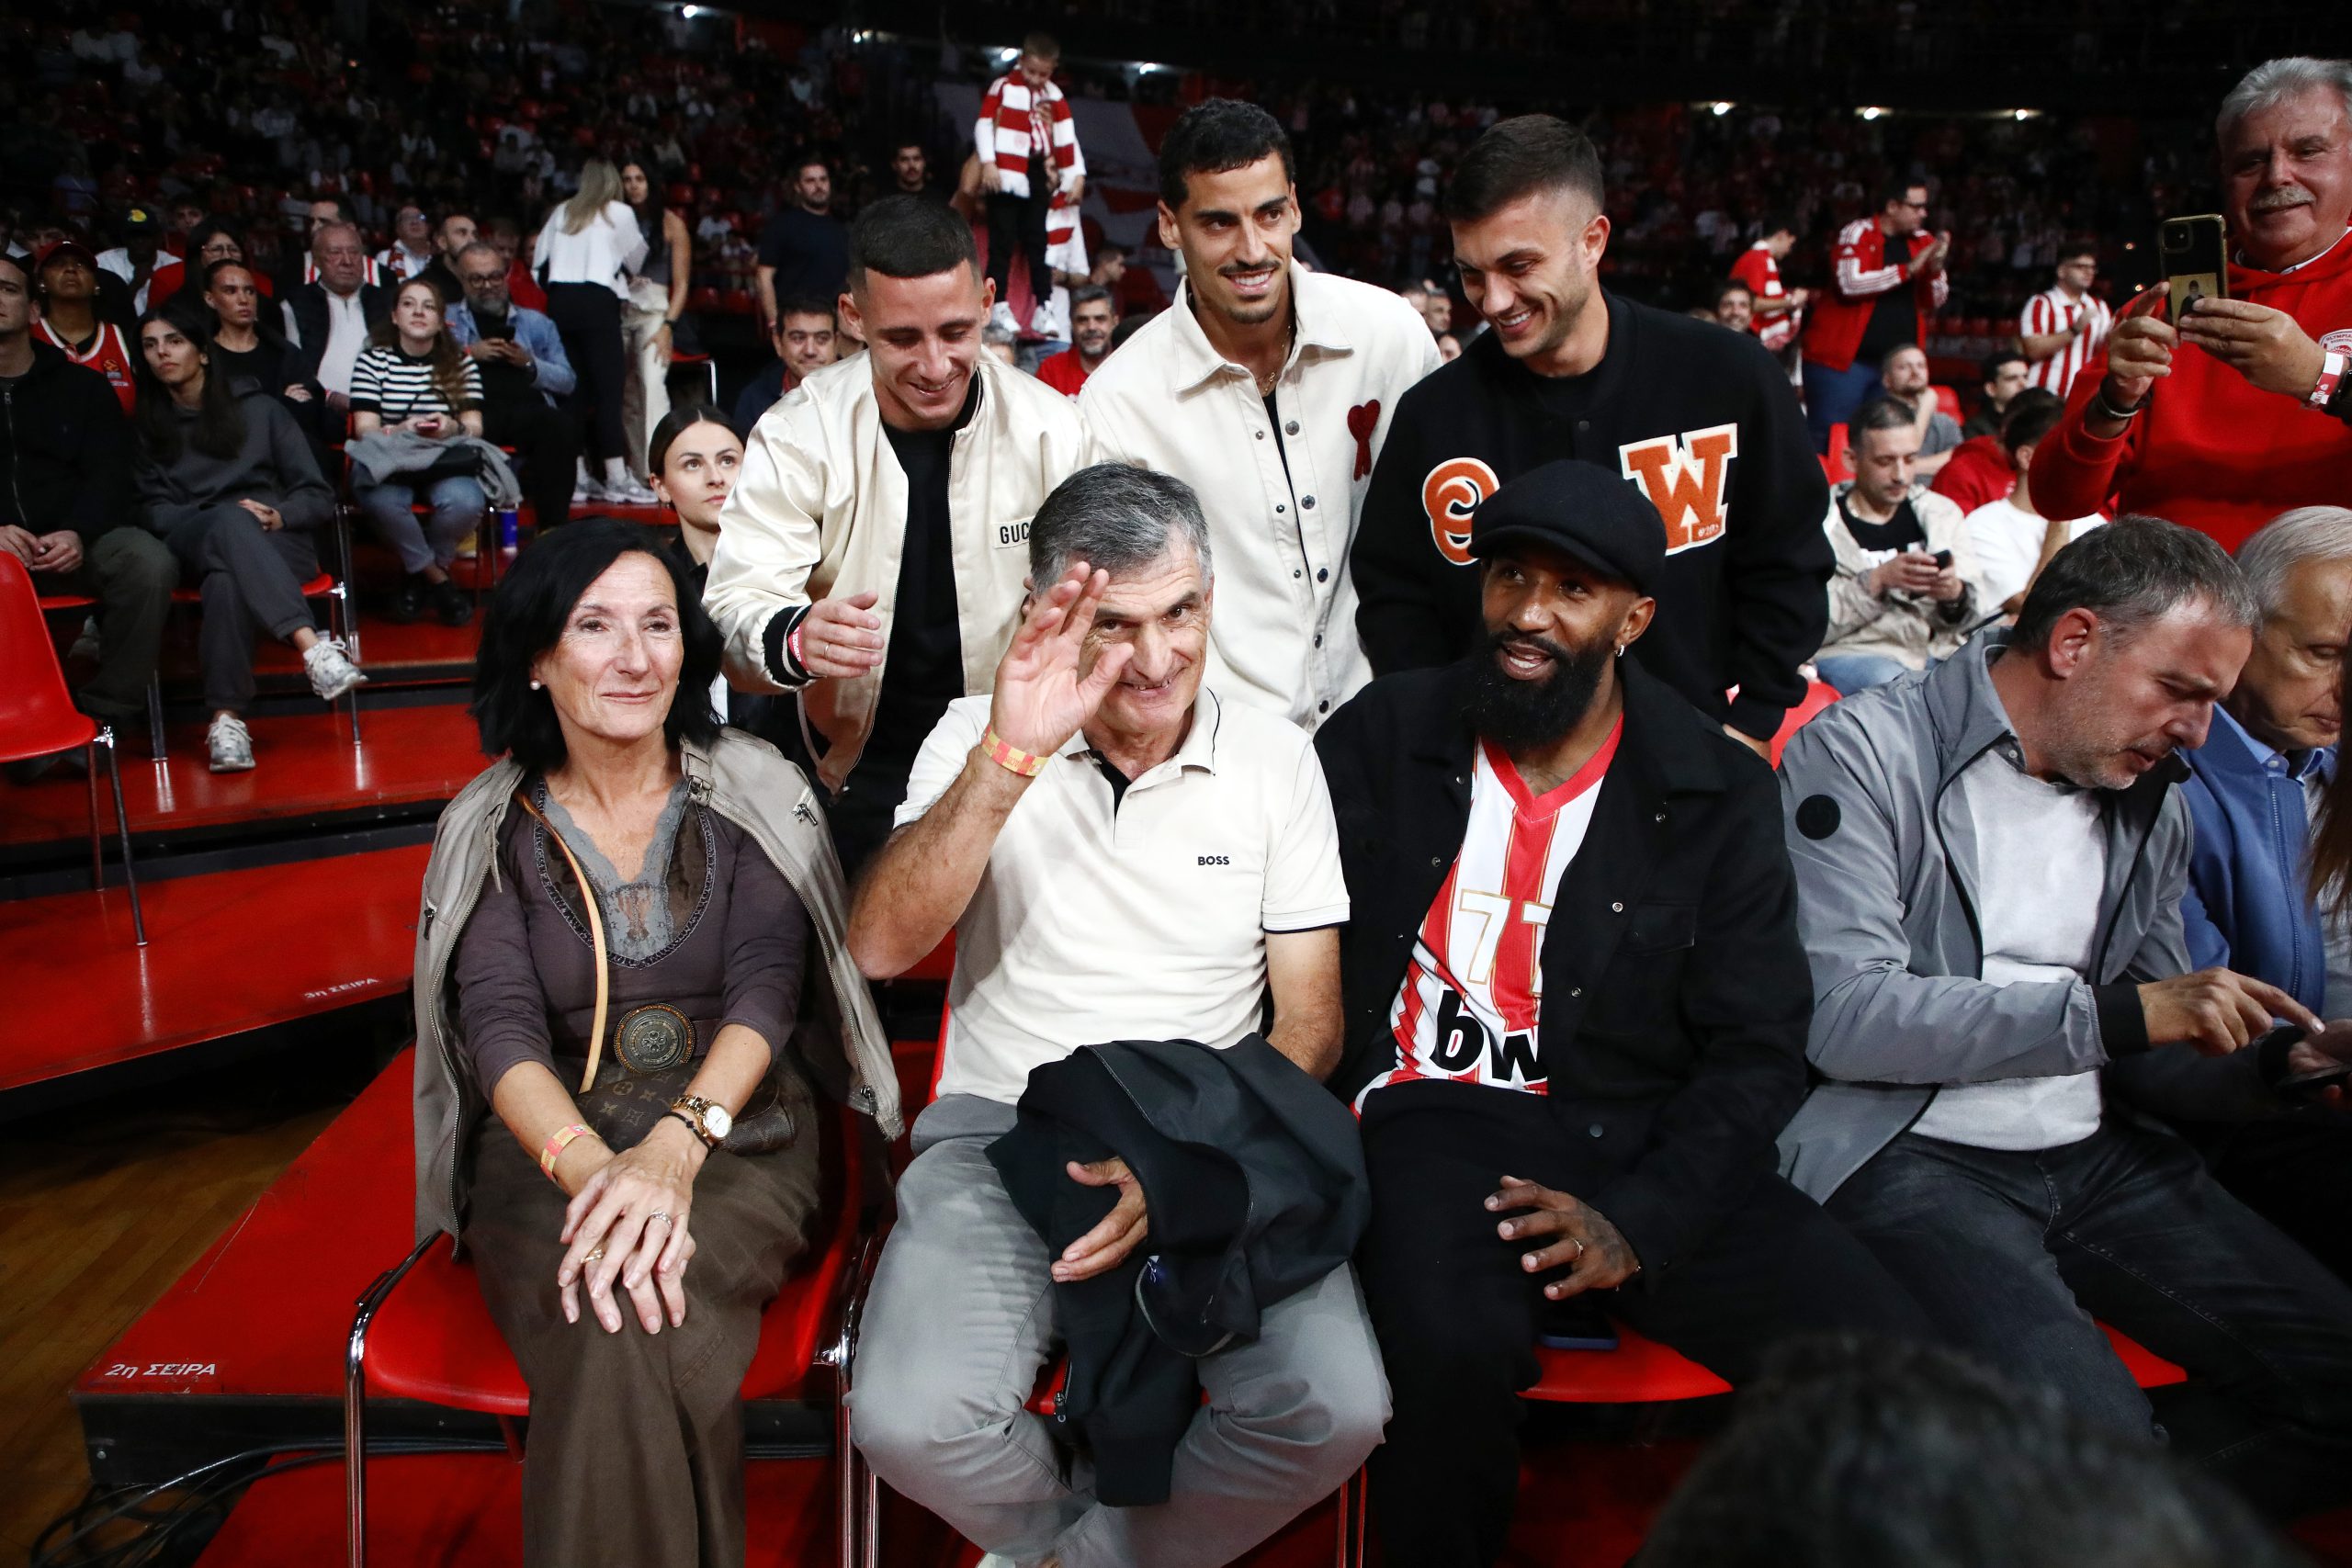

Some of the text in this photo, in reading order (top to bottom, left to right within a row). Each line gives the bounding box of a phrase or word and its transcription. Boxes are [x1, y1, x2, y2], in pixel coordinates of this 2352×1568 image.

[1619, 423, 1737, 556] W
[1000, 522, 1029, 544] GUC
[1197, 855, 1230, 866] BOSS
[104, 1363, 216, 1379] 2η ΣΕΙΡΑ
